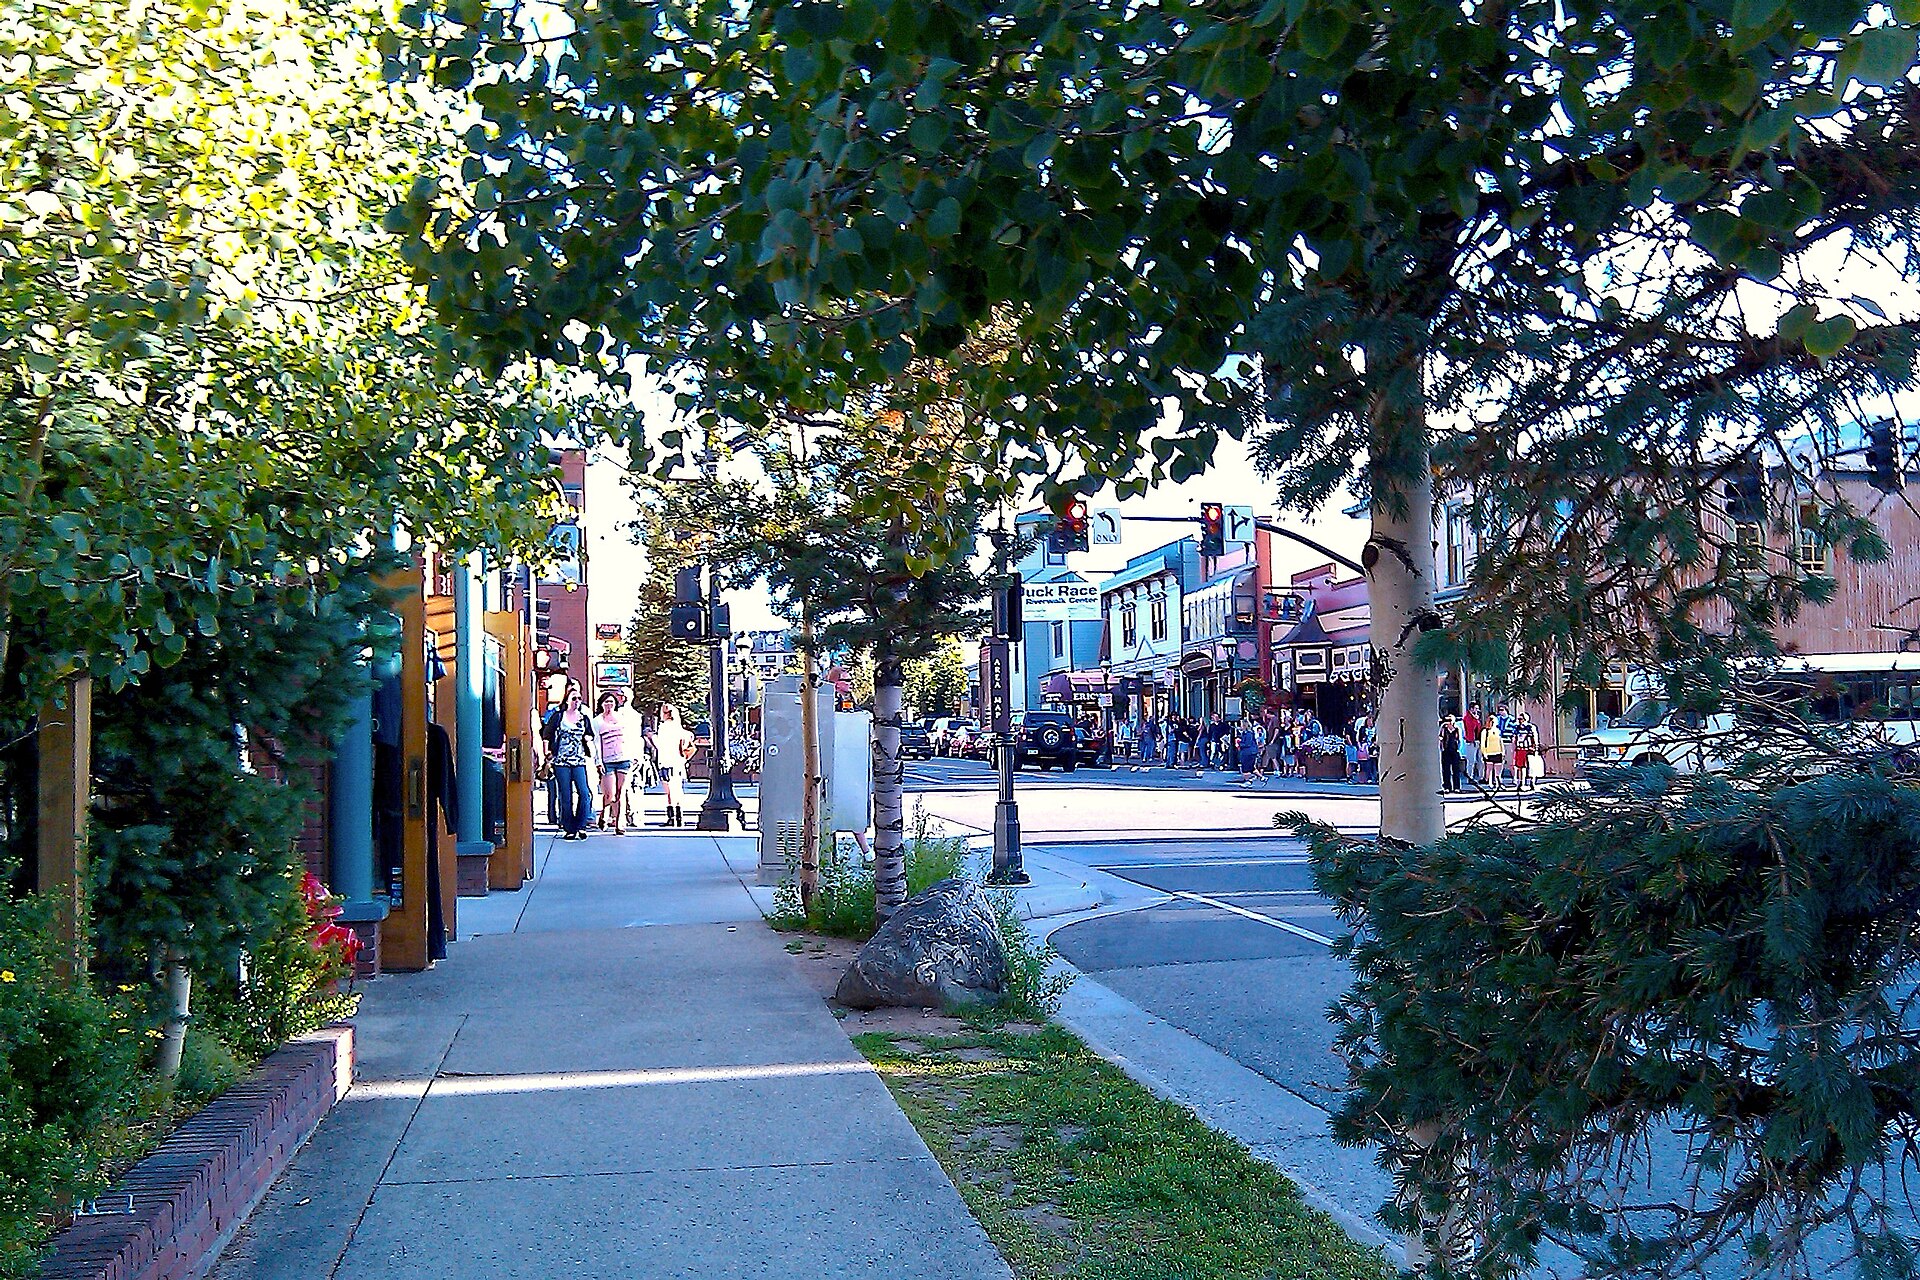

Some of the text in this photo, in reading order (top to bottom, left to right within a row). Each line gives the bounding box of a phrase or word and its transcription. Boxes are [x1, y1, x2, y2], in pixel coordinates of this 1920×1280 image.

[1096, 534, 1118, 542] ONLY
[1058, 585, 1098, 597] Race
[993, 658, 1002, 719] AREA MAP
[1072, 692, 1099, 701] ERIC'
